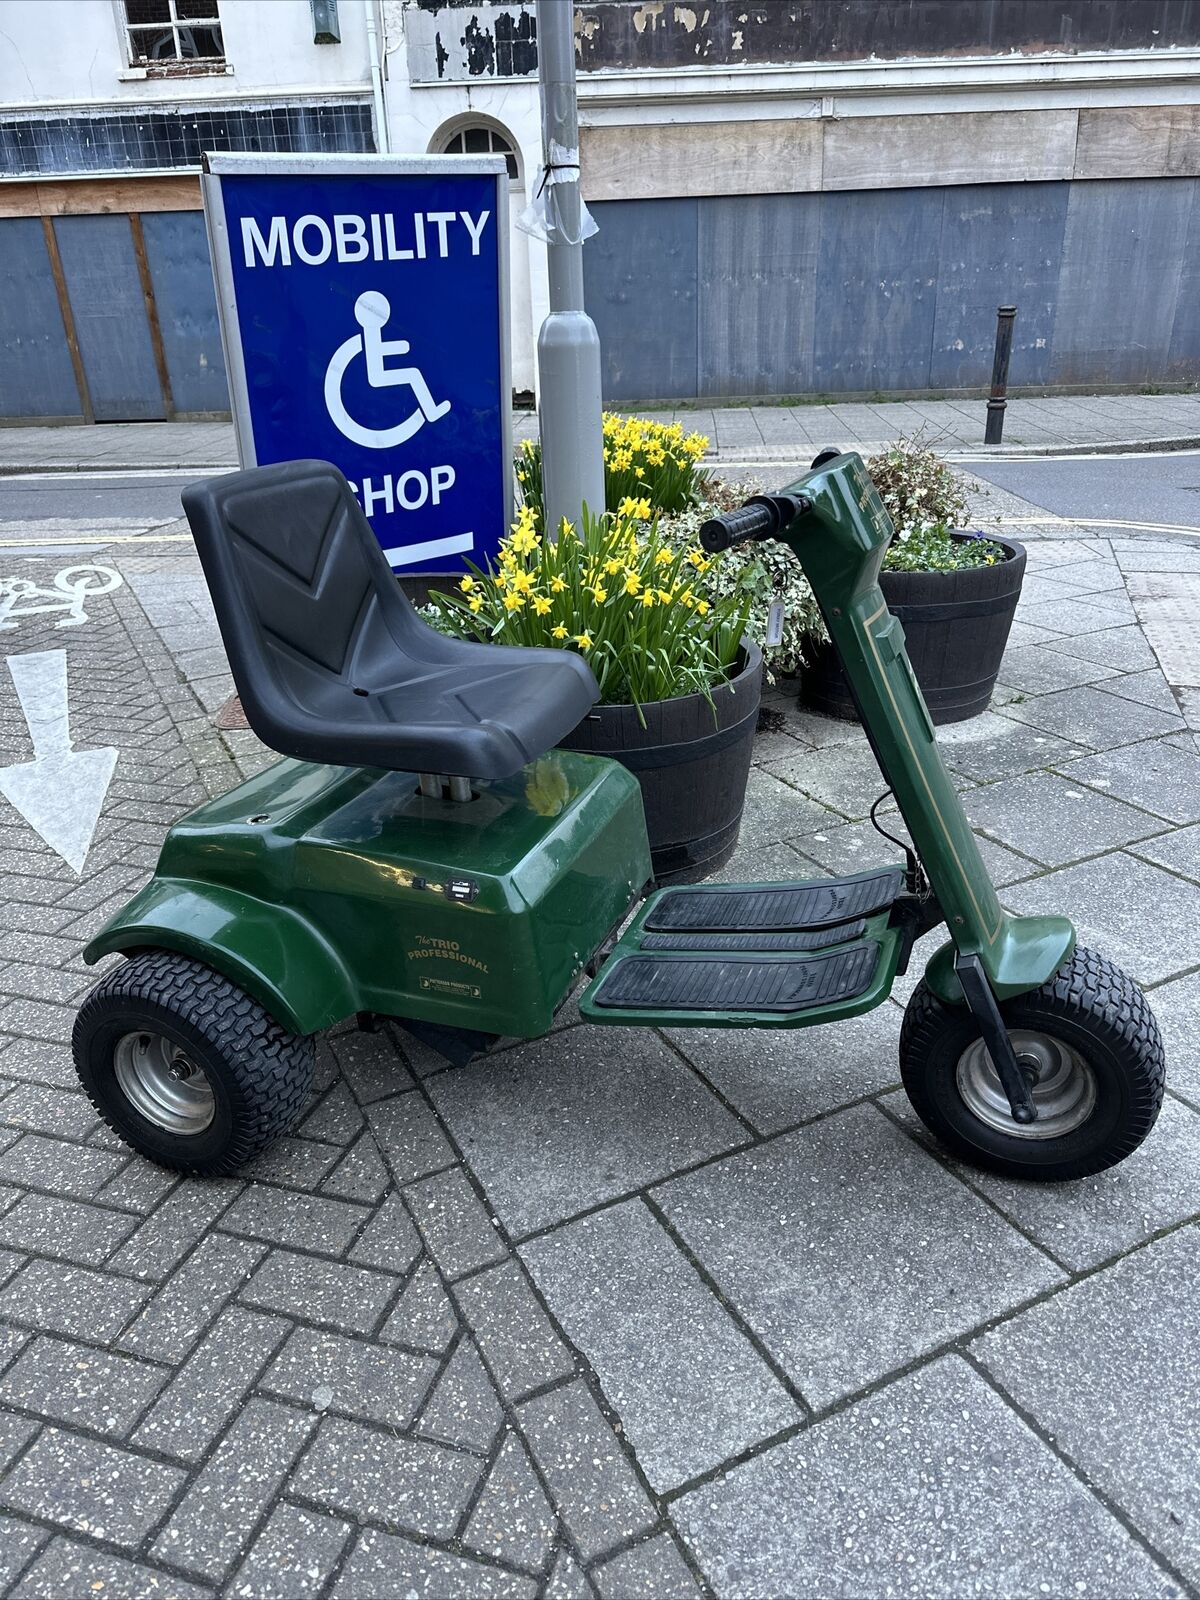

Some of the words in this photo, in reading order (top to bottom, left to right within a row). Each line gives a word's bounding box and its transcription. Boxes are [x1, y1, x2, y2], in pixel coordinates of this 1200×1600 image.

[240, 210, 491, 268] MOBILITY
[430, 938, 460, 951] TRIO
[407, 949, 489, 974] PROFESSIONAL
